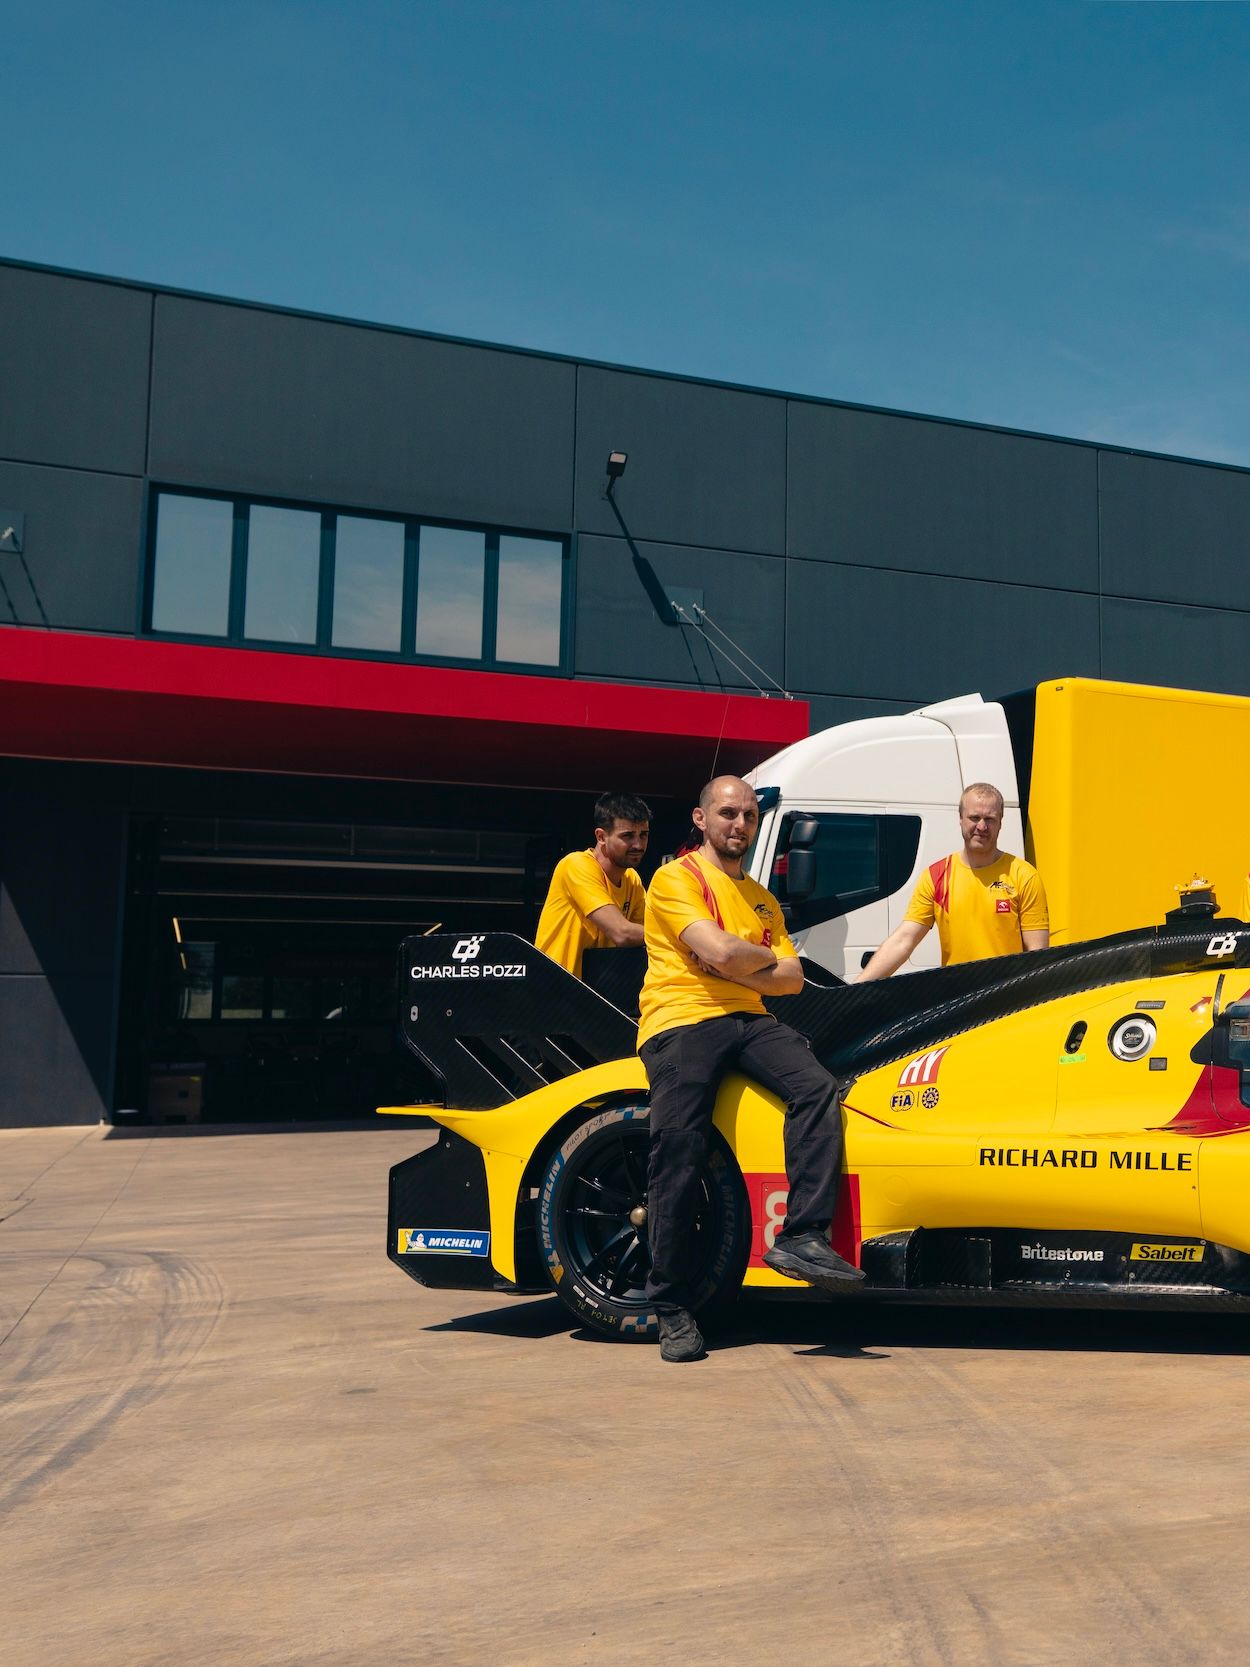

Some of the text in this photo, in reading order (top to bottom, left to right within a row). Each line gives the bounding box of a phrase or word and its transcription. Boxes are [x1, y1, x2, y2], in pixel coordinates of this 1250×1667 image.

[411, 965, 526, 979] CHARLES POZZI
[899, 1045, 951, 1086] HY
[979, 1148, 1192, 1172] RICHARD MILLE
[541, 1159, 561, 1249] MICHELIN
[428, 1237, 483, 1249] MICHELIN
[1020, 1243, 1104, 1262] Britestone
[1138, 1245, 1197, 1261] Sabelt
